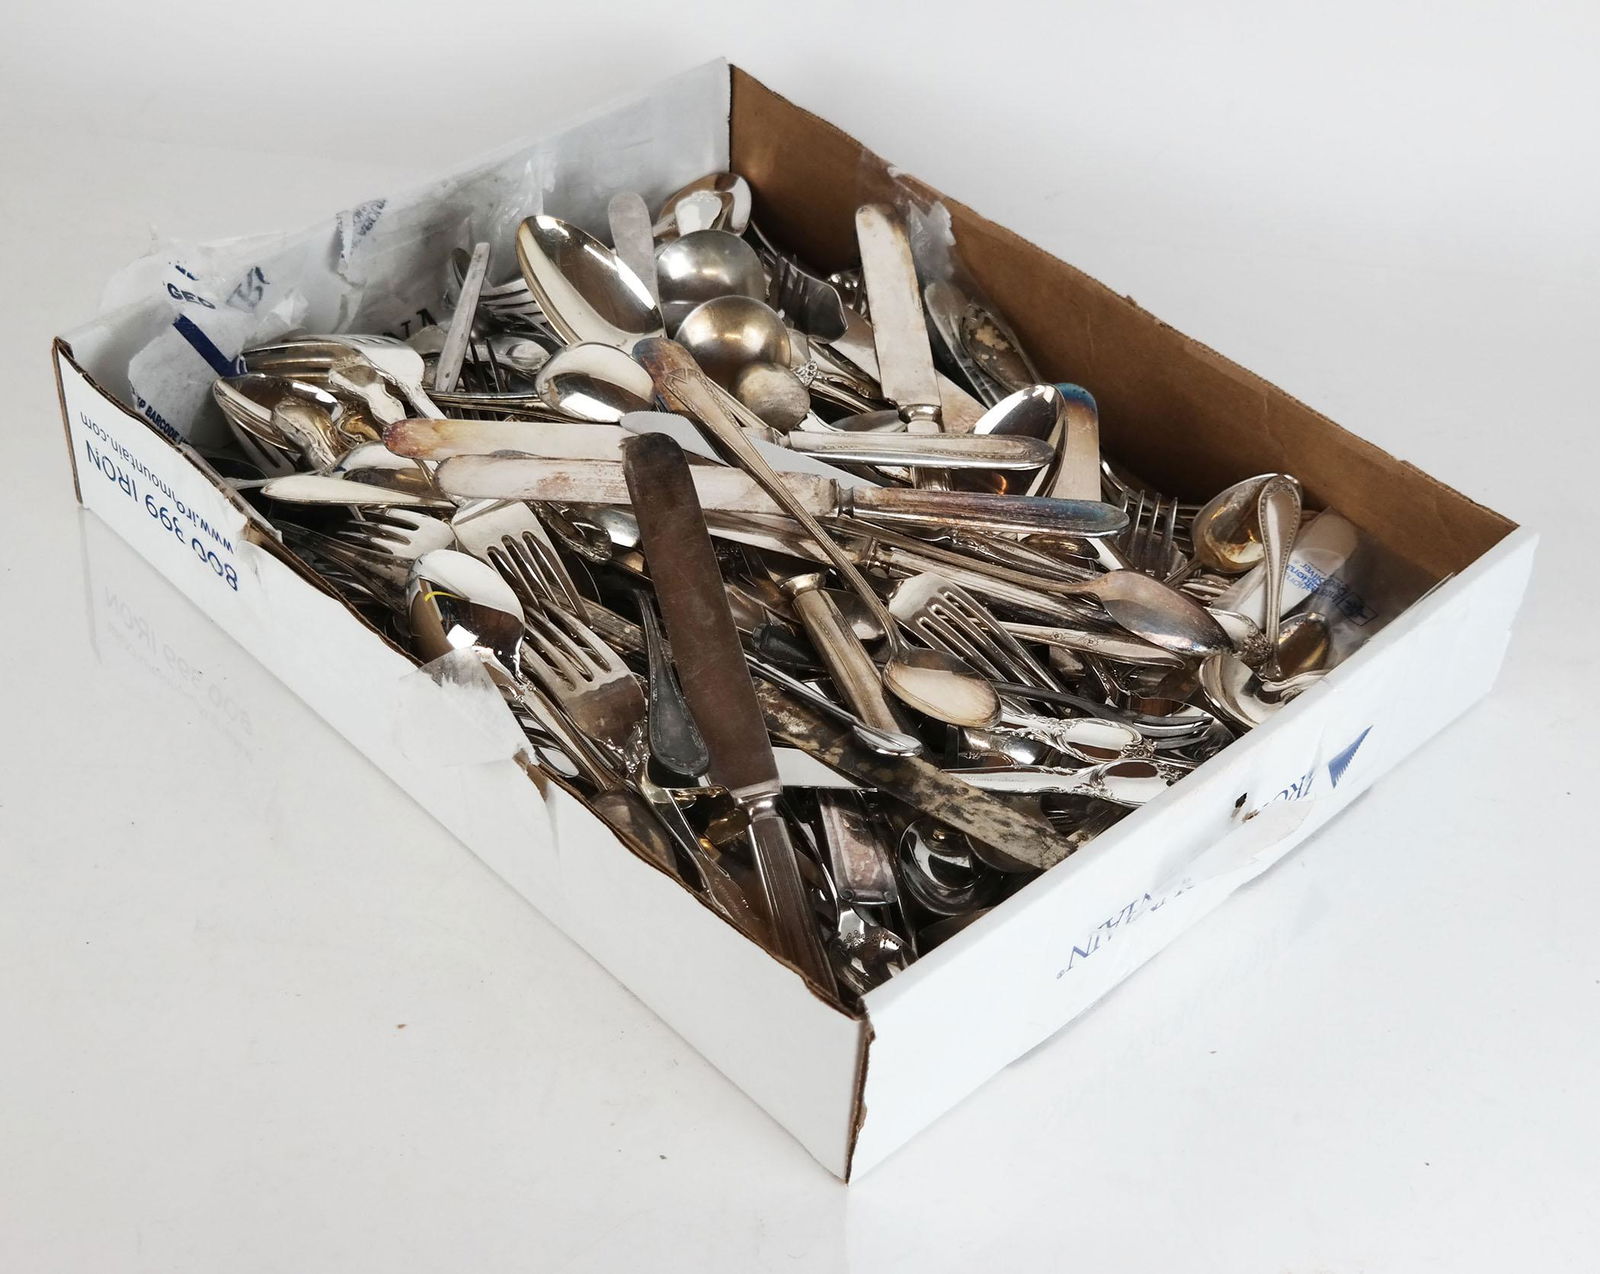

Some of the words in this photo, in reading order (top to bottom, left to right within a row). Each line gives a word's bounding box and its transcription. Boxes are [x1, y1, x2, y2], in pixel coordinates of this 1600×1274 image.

[145, 405, 180, 442] BARCODE
[79, 411, 235, 554] www.ironmountain.com
[85, 439, 138, 502] IRON
[144, 494, 185, 544] 399
[191, 537, 239, 592] 800
